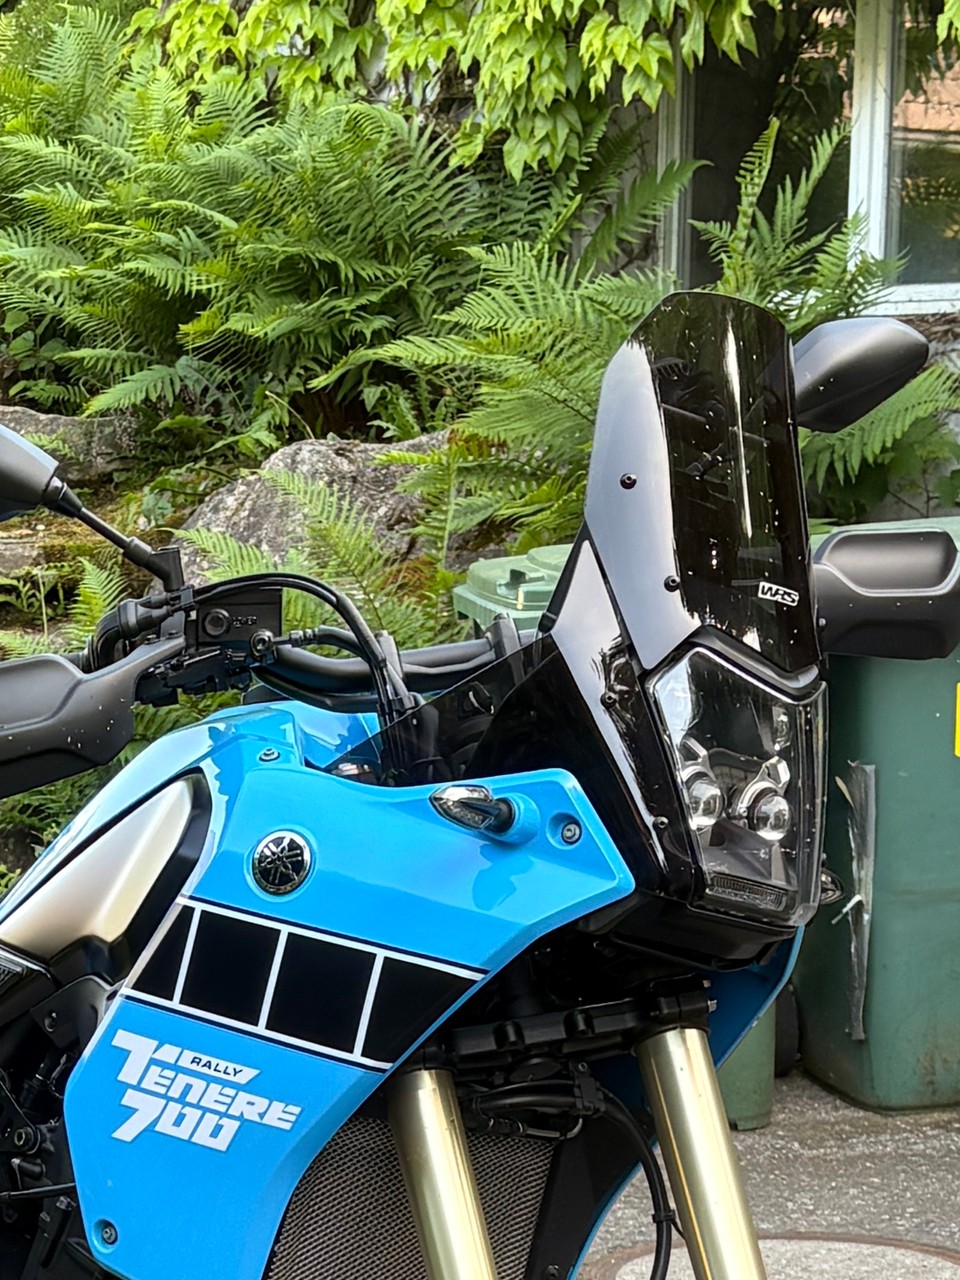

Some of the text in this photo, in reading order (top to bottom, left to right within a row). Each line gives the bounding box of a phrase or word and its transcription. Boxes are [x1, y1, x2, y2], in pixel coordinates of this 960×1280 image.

[759, 583, 799, 605] WRS
[189, 1055, 244, 1078] RALLY
[111, 1088, 242, 1152] 700
